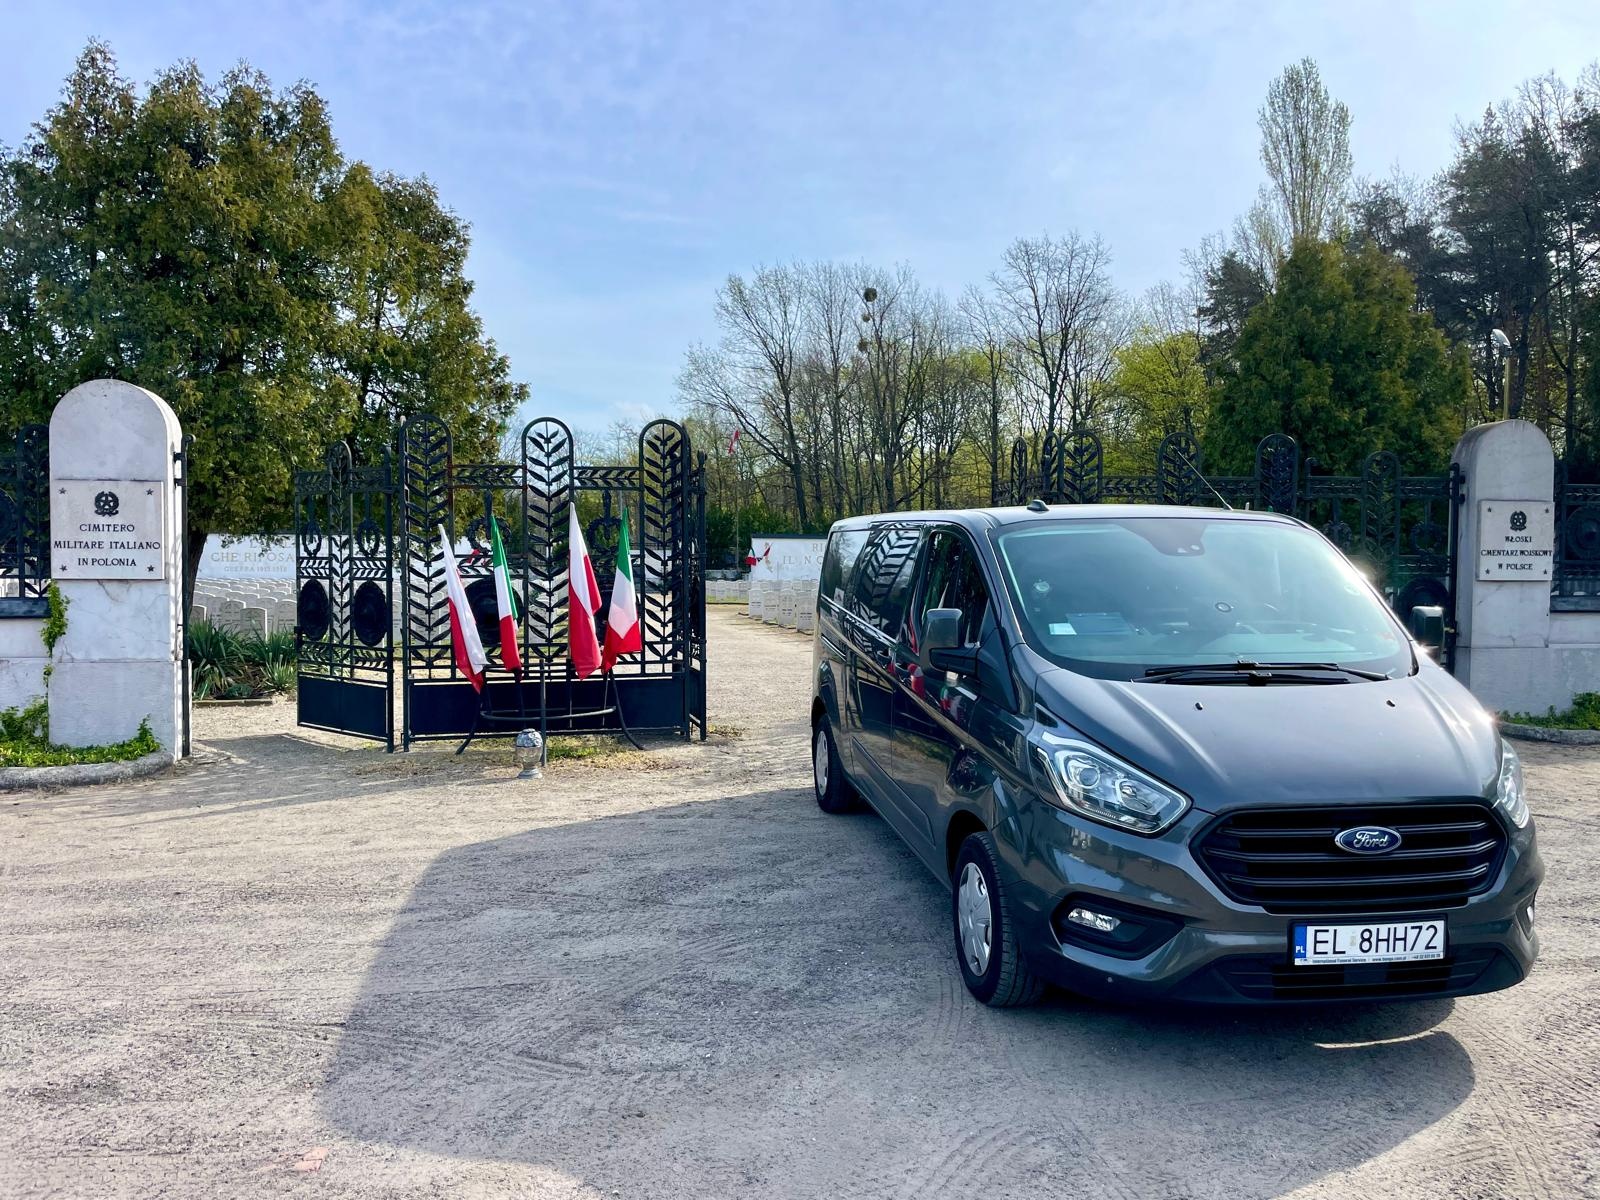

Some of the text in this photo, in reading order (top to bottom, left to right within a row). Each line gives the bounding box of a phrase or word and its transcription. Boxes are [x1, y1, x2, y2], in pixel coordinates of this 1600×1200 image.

[80, 523, 135, 532] CIMITERO
[1505, 535, 1532, 543] WŁOSKI
[53, 540, 161, 550] MILITARE ITALIANO
[211, 552, 239, 562] CHE
[1480, 549, 1552, 557] CMENTARZ WOJSKOWY
[78, 557, 137, 567] IN POLONIA
[1506, 563, 1533, 571] POLSCE
[1353, 830, 1389, 848] Ford
[1313, 924, 1438, 955] EL 8HH72
[1295, 945, 1305, 954] PL
